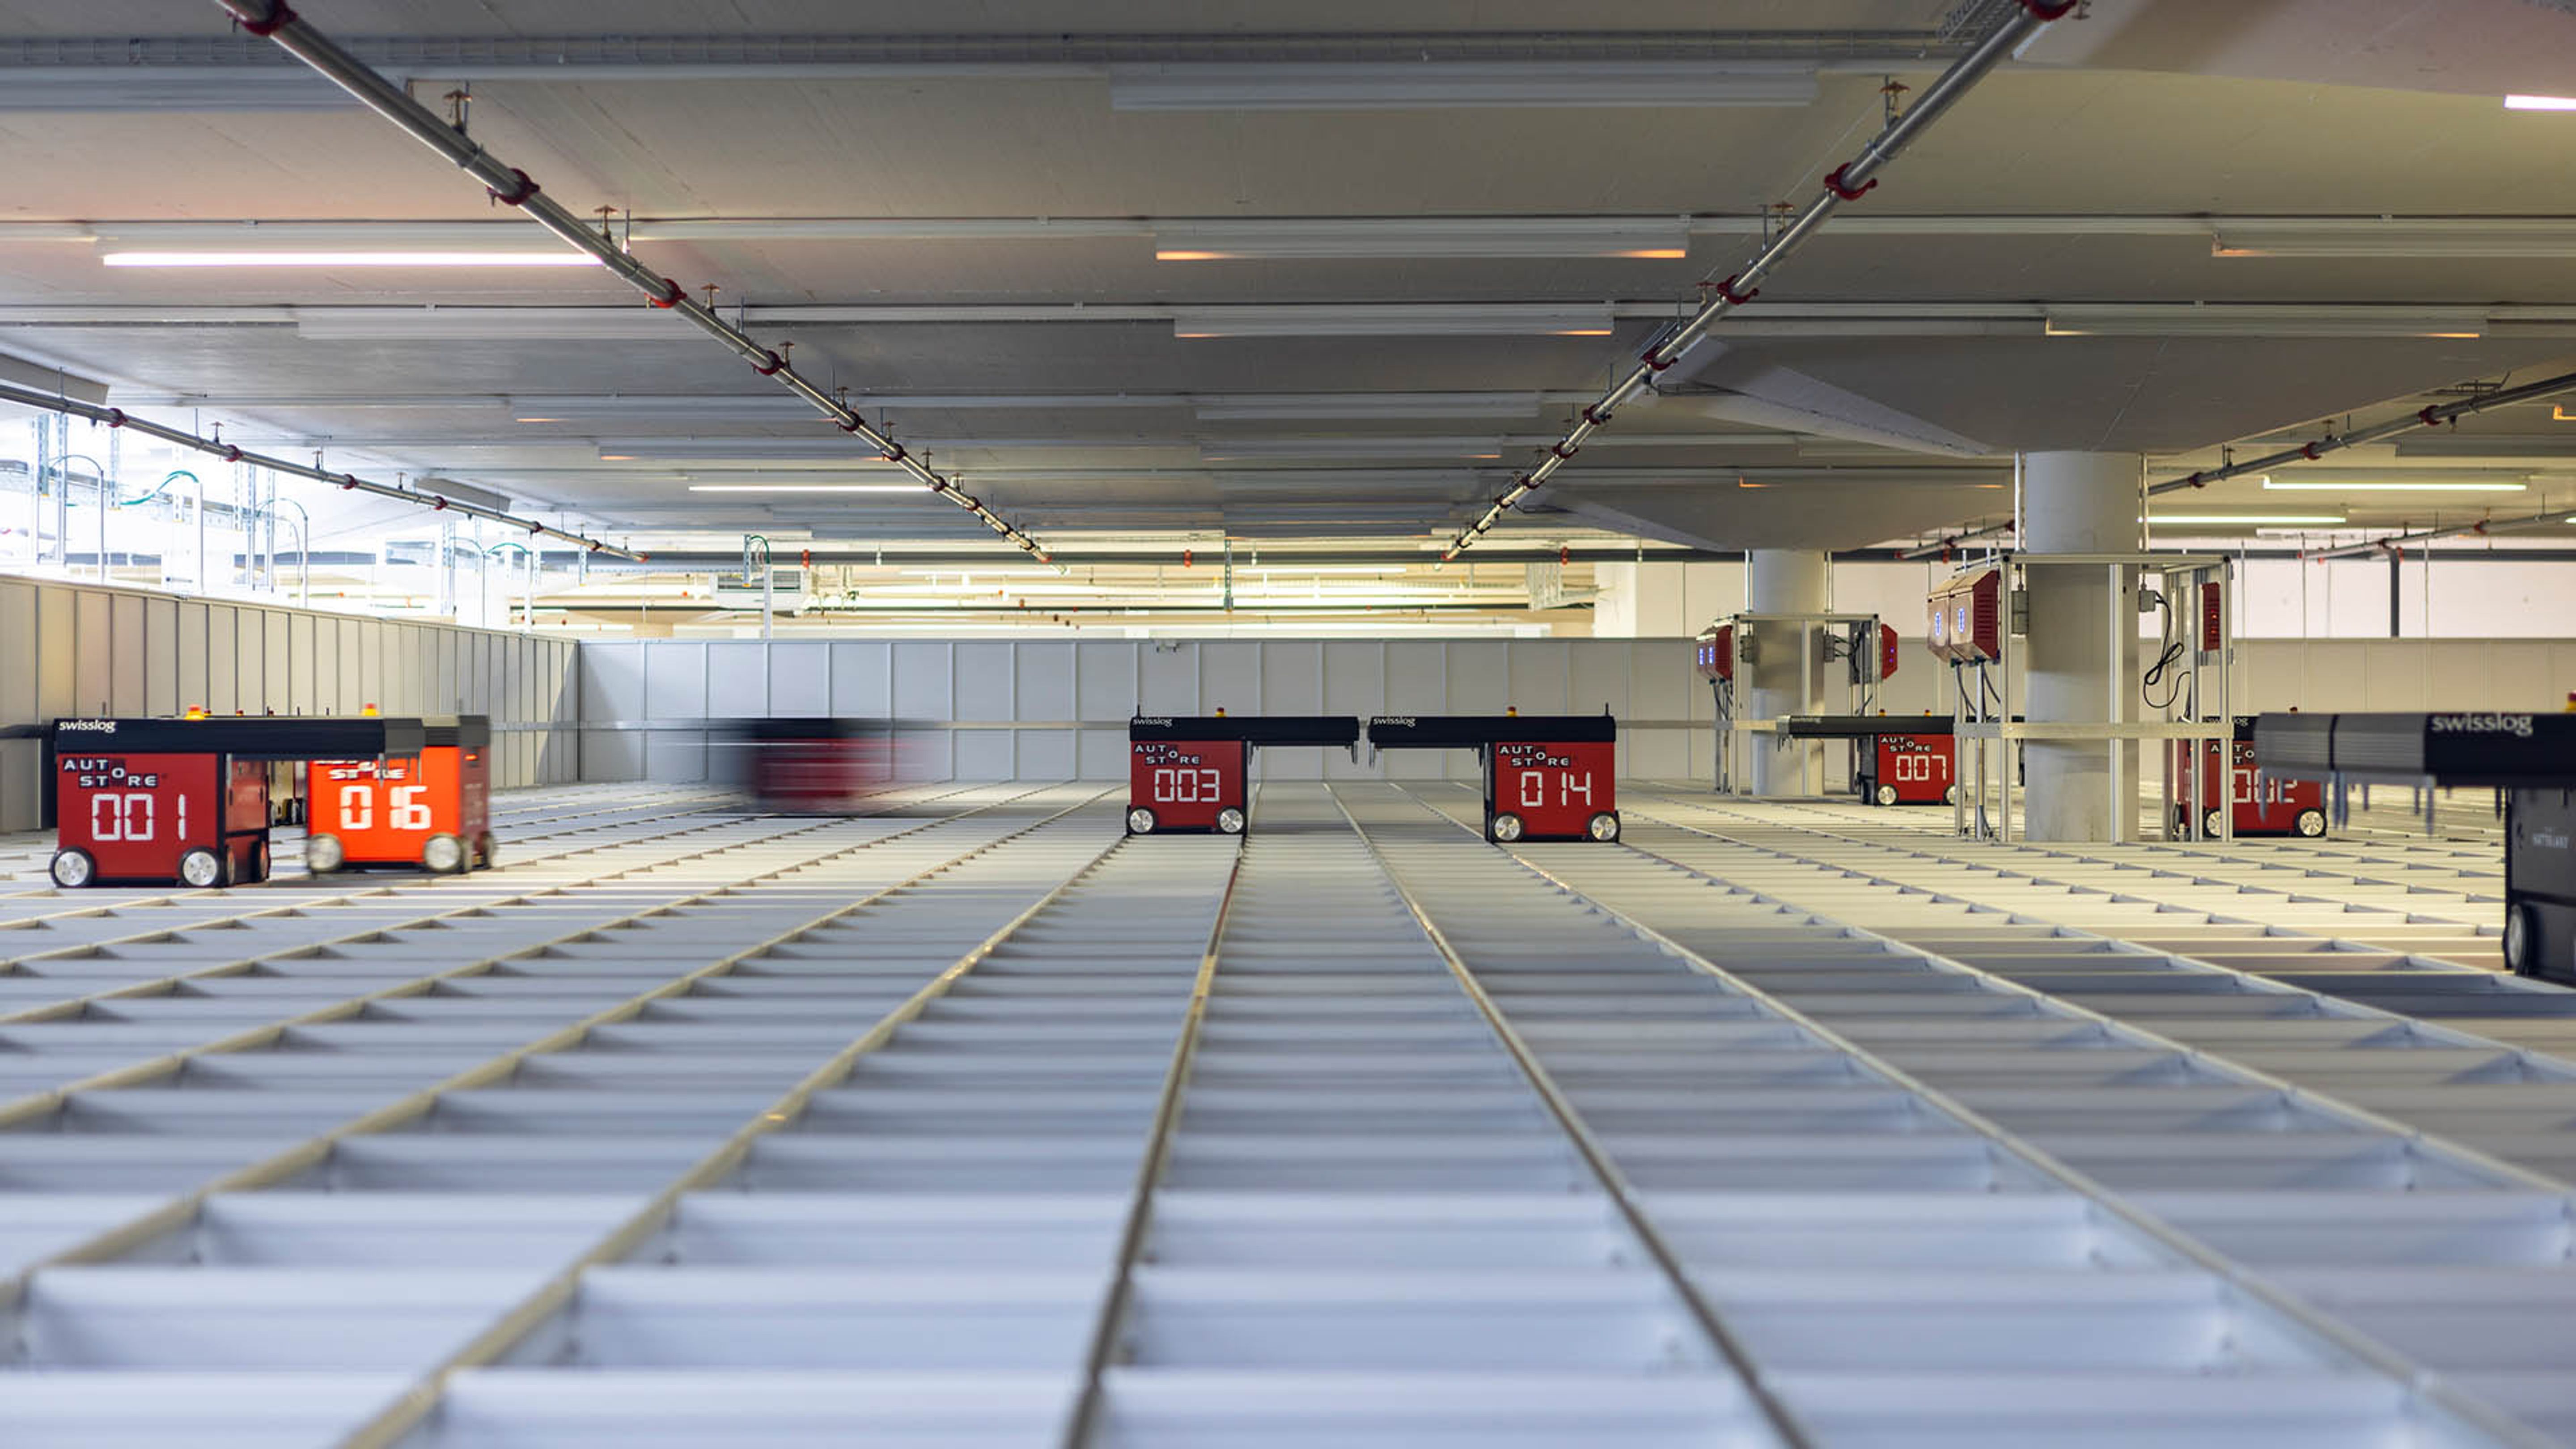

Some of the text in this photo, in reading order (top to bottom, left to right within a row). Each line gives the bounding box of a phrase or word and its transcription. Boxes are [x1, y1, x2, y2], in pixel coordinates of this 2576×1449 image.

[59, 719, 116, 733] swisslog
[1132, 717, 1172, 728] swisslog
[1373, 717, 1416, 728] swisslog
[2432, 714, 2533, 736] swisslog
[1896, 755, 1947, 781] 007
[1154, 769, 1220, 802] 003
[1521, 771, 1591, 806] 014
[92, 793, 186, 841] 001
